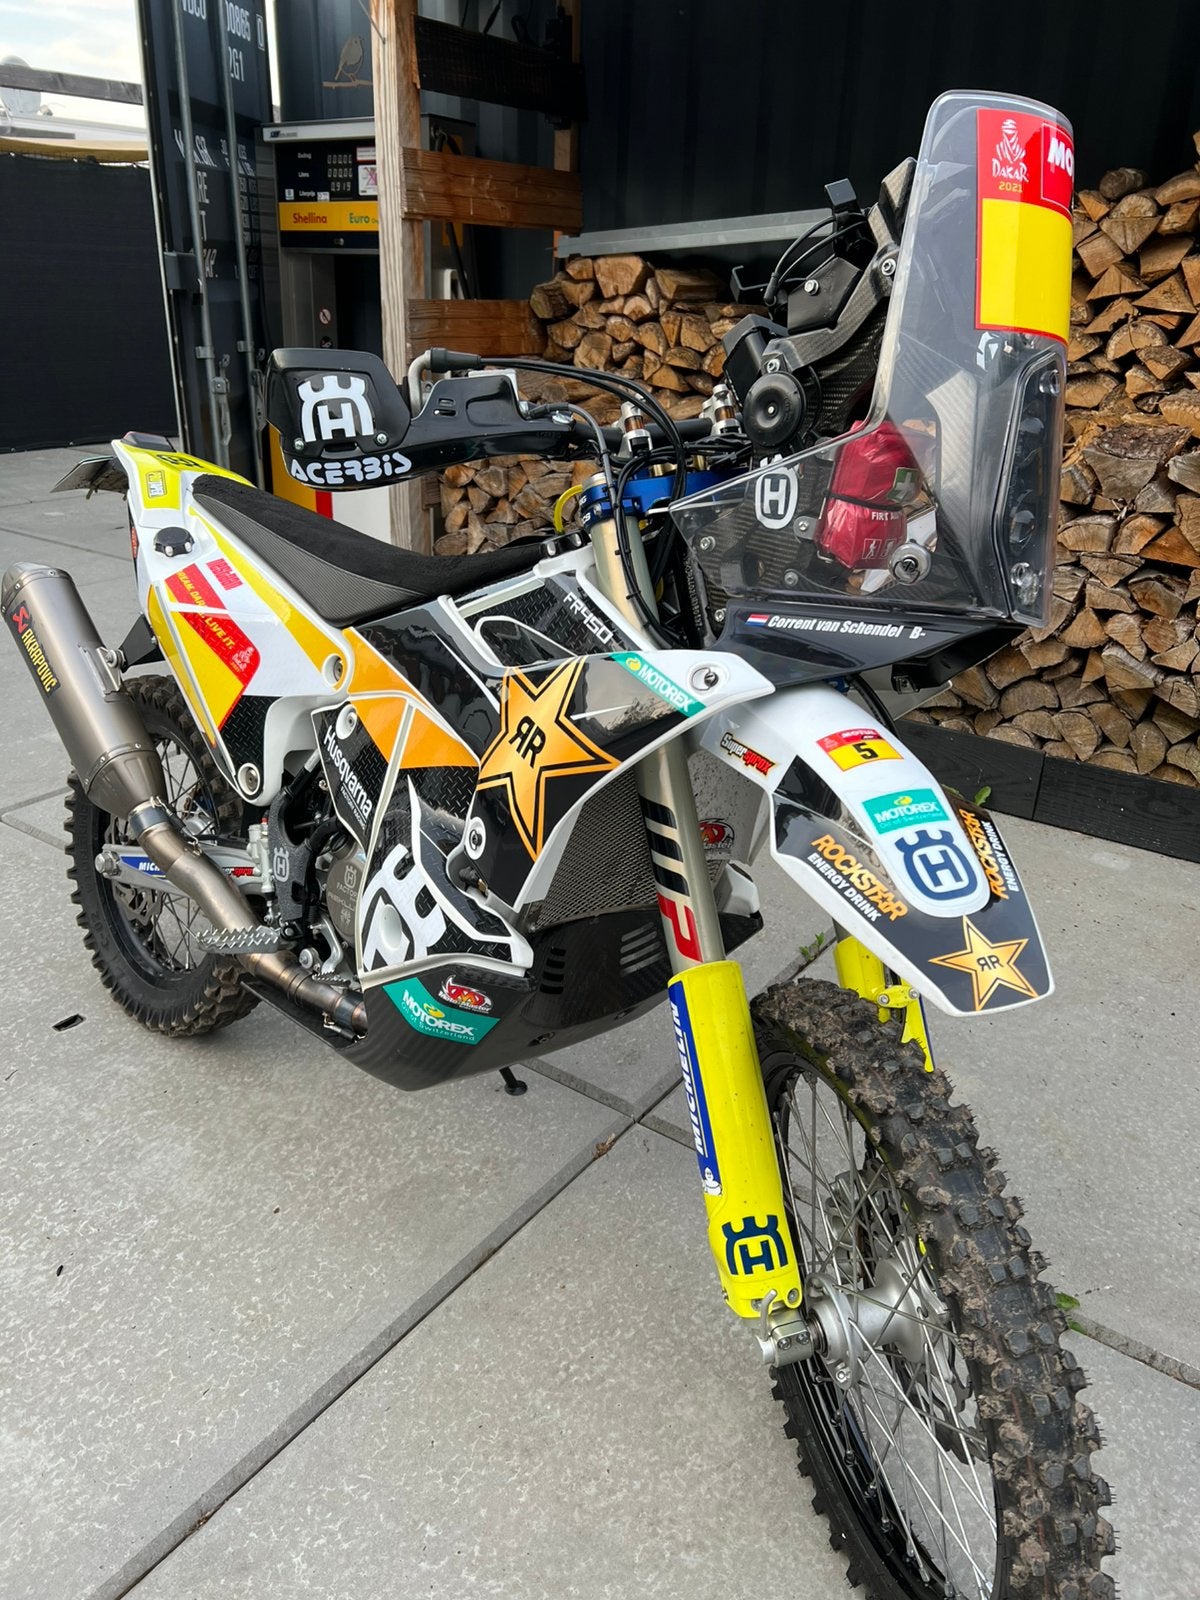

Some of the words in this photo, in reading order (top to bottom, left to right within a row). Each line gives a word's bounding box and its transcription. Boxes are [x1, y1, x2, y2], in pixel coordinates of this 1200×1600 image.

[992, 158, 1029, 183] DAKAR
[999, 181, 1023, 193] 2021
[292, 212, 328, 224] Shellina
[349, 212, 370, 224] Euro
[562, 591, 614, 645] FR450
[768, 615, 814, 631] Corrent
[816, 621, 839, 633] van
[840, 620, 904, 638] Schendel
[910, 626, 926, 640] B-
[639, 663, 693, 713] MOTOREX
[324, 724, 373, 820] Husqvarna
[852, 742, 879, 760] 5
[874, 801, 941, 824] MOTOREX
[958, 808, 1010, 900] ROCKSTAR
[981, 821, 1004, 854] DRINK
[807, 852, 845, 891] ENERGY
[843, 886, 883, 923] DRINK
[811, 833, 909, 922] ROCKSTAR
[994, 850, 1020, 892] ENERGY
[403, 989, 475, 1036] MOTOREX
[419, 1022, 475, 1041] Switzerland
[669, 1001, 705, 1157] MICHELIN
